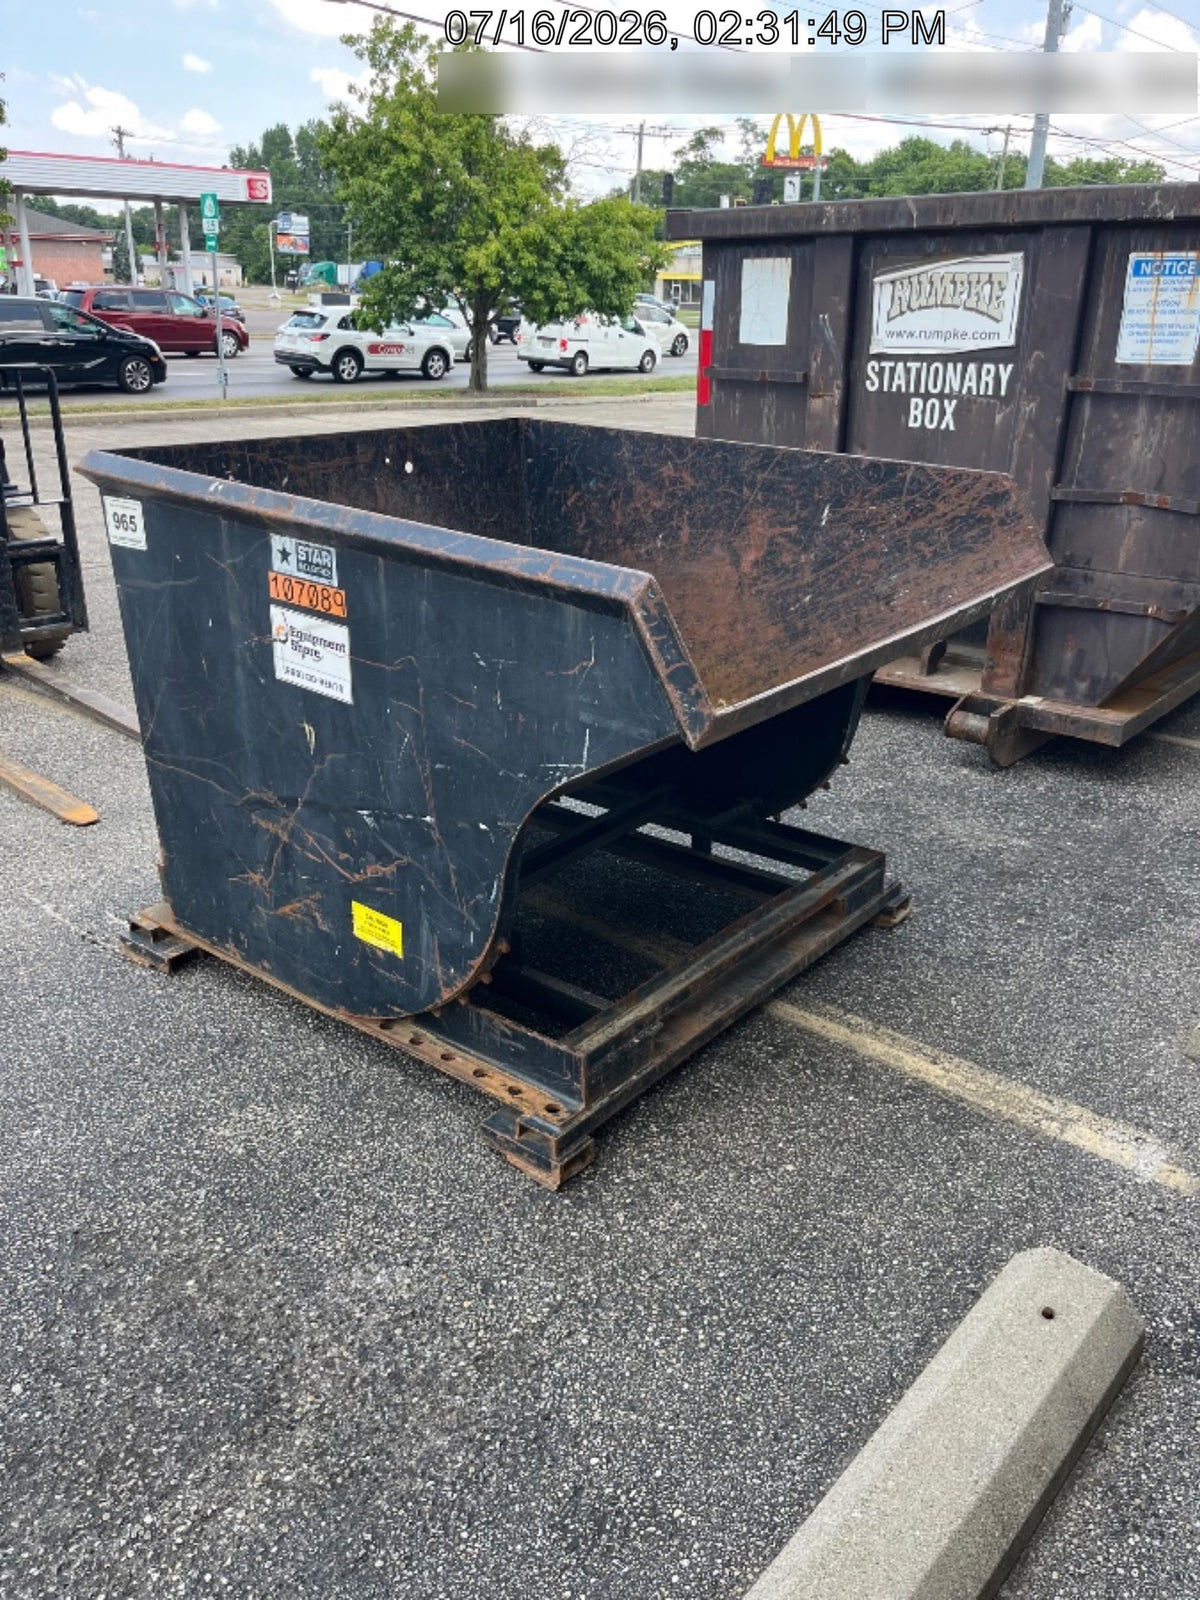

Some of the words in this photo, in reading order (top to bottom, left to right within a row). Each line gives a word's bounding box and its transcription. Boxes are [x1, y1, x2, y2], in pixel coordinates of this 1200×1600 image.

[1140, 261, 1197, 275] NOTICE
[887, 271, 1009, 323] RUMPKE
[884, 326, 1001, 342] www.rumpke.com
[865, 360, 1014, 397] STATIONARY
[908, 397, 958, 431] BOX
[112, 511, 138, 533] 965
[298, 545, 331, 568] STAR
[271, 575, 346, 616] 107089
[289, 625, 346, 654] Equipment
